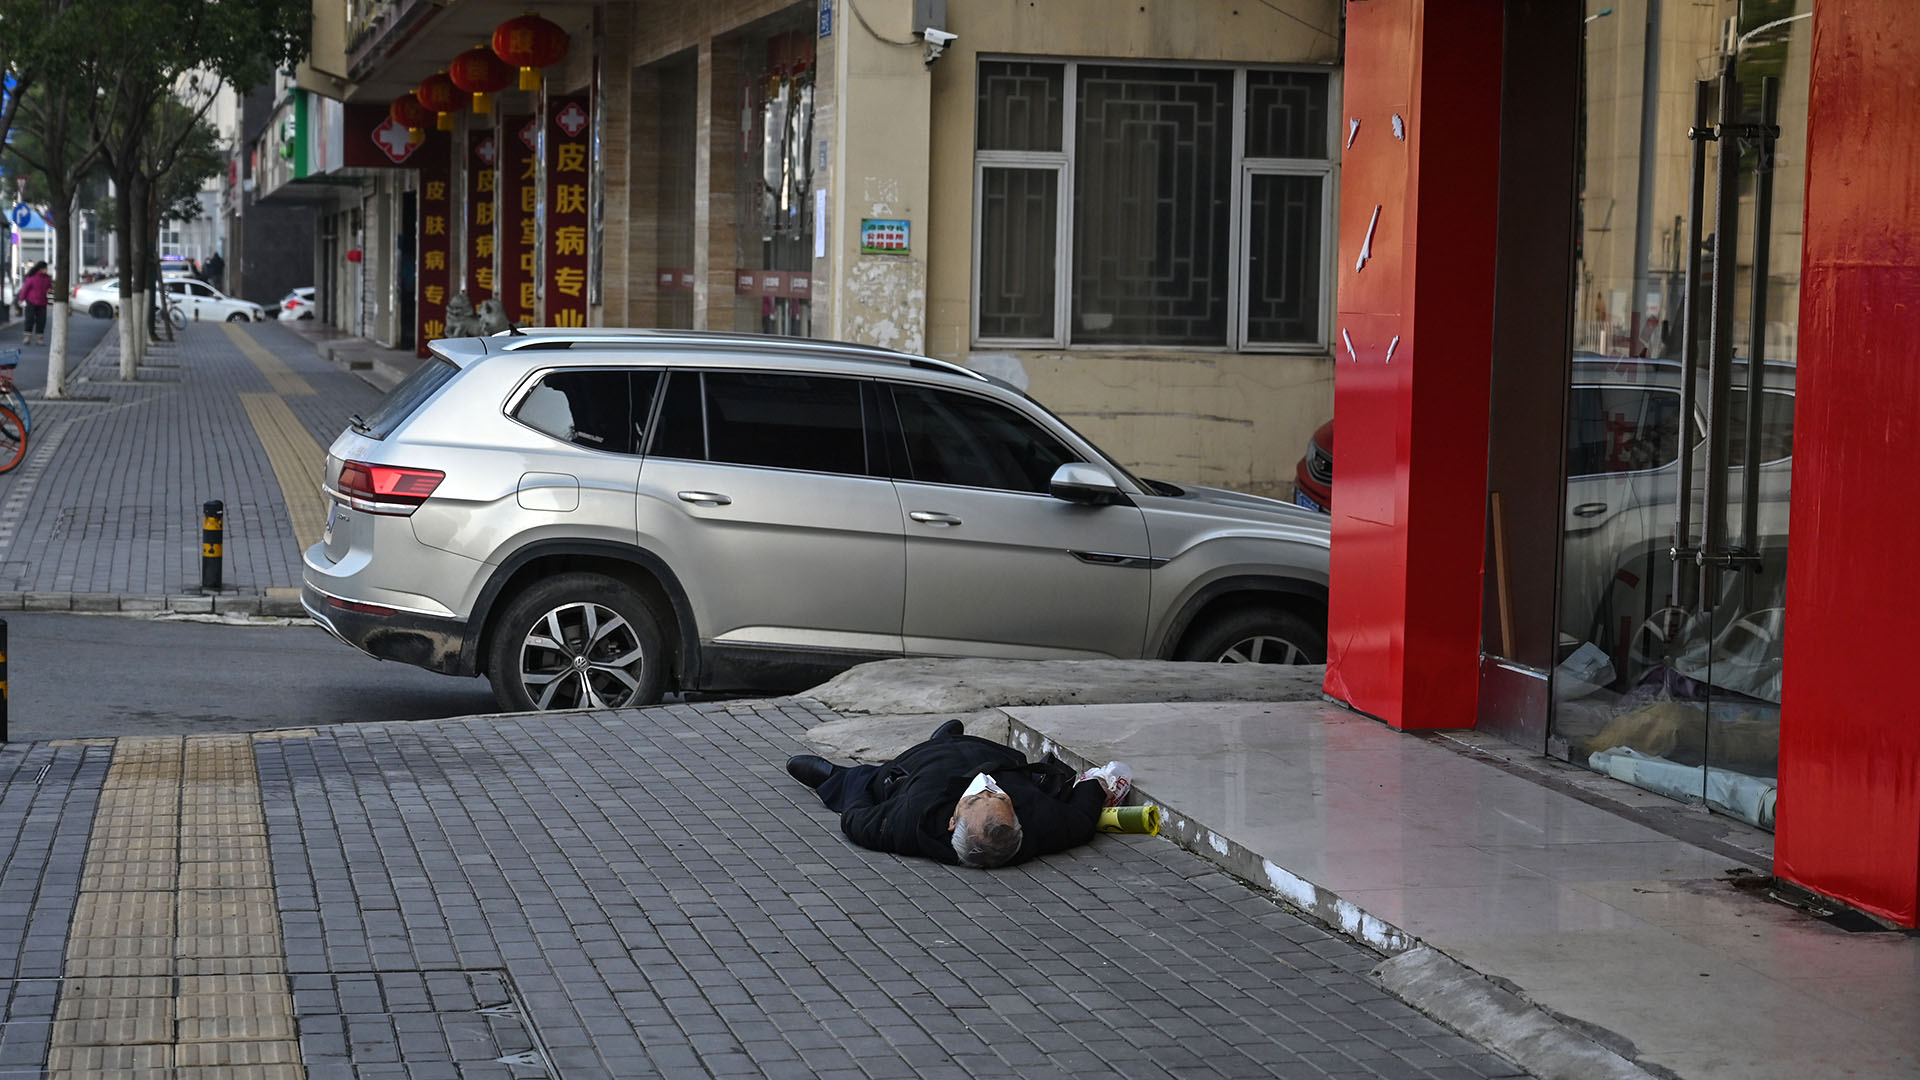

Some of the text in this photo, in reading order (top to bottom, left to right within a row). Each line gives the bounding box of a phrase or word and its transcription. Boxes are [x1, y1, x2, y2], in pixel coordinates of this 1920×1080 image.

[424, 181, 445, 339] 皮肤病专业
[475, 170, 494, 310] 皮肤病专
[555, 142, 586, 328] 皮肤病专业
